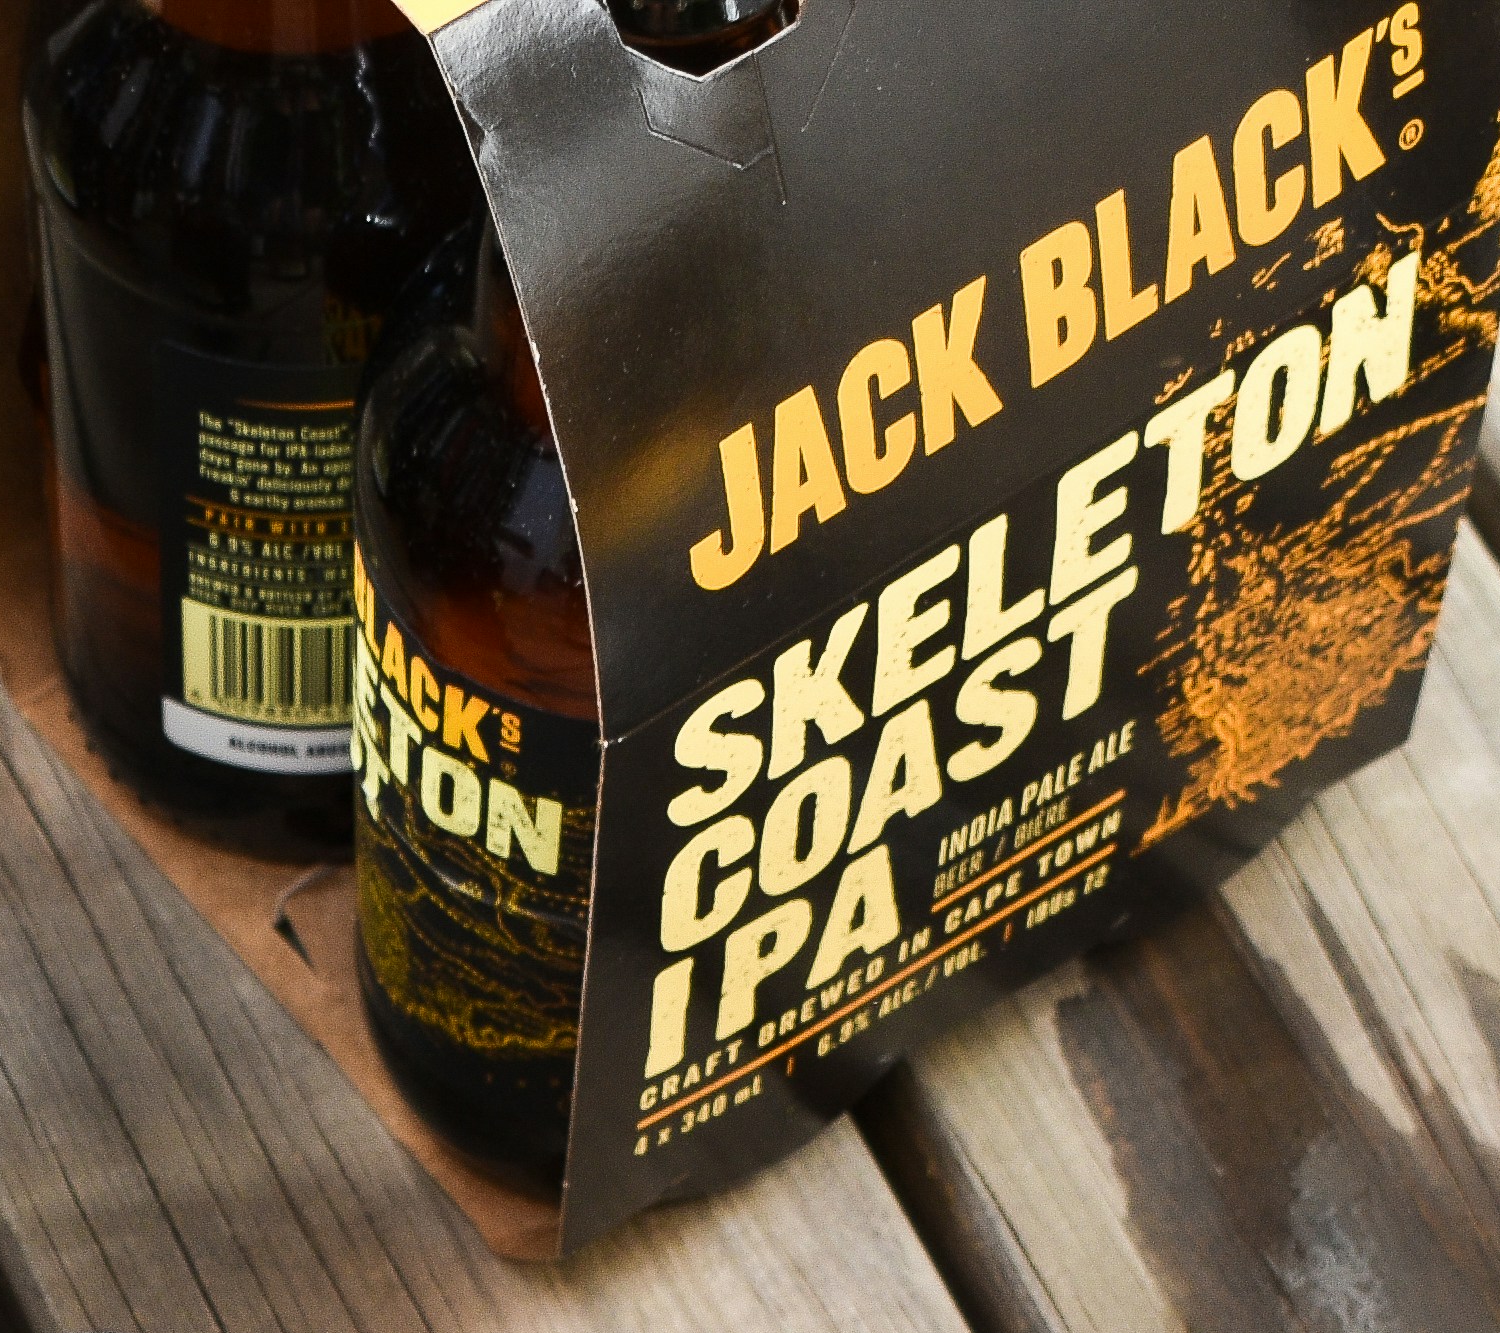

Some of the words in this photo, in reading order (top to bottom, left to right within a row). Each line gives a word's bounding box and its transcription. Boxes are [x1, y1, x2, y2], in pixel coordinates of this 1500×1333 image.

[689, 275, 1004, 592] JACK
[1019, 7, 1425, 389] BLACK'S
[666, 250, 1420, 828] SKELETON
[659, 566, 1139, 952] COAST
[938, 796, 1013, 867] INDIA
[1020, 751, 1085, 816] PALE
[1088, 720, 1137, 774] ALE
[639, 1039, 743, 1111] CRAFT
[758, 955, 885, 1049] BREWED
[898, 927, 932, 963] IN
[944, 870, 1023, 934] CAPE
[1038, 808, 1122, 878] TOWN
[644, 845, 900, 1078] IPA
